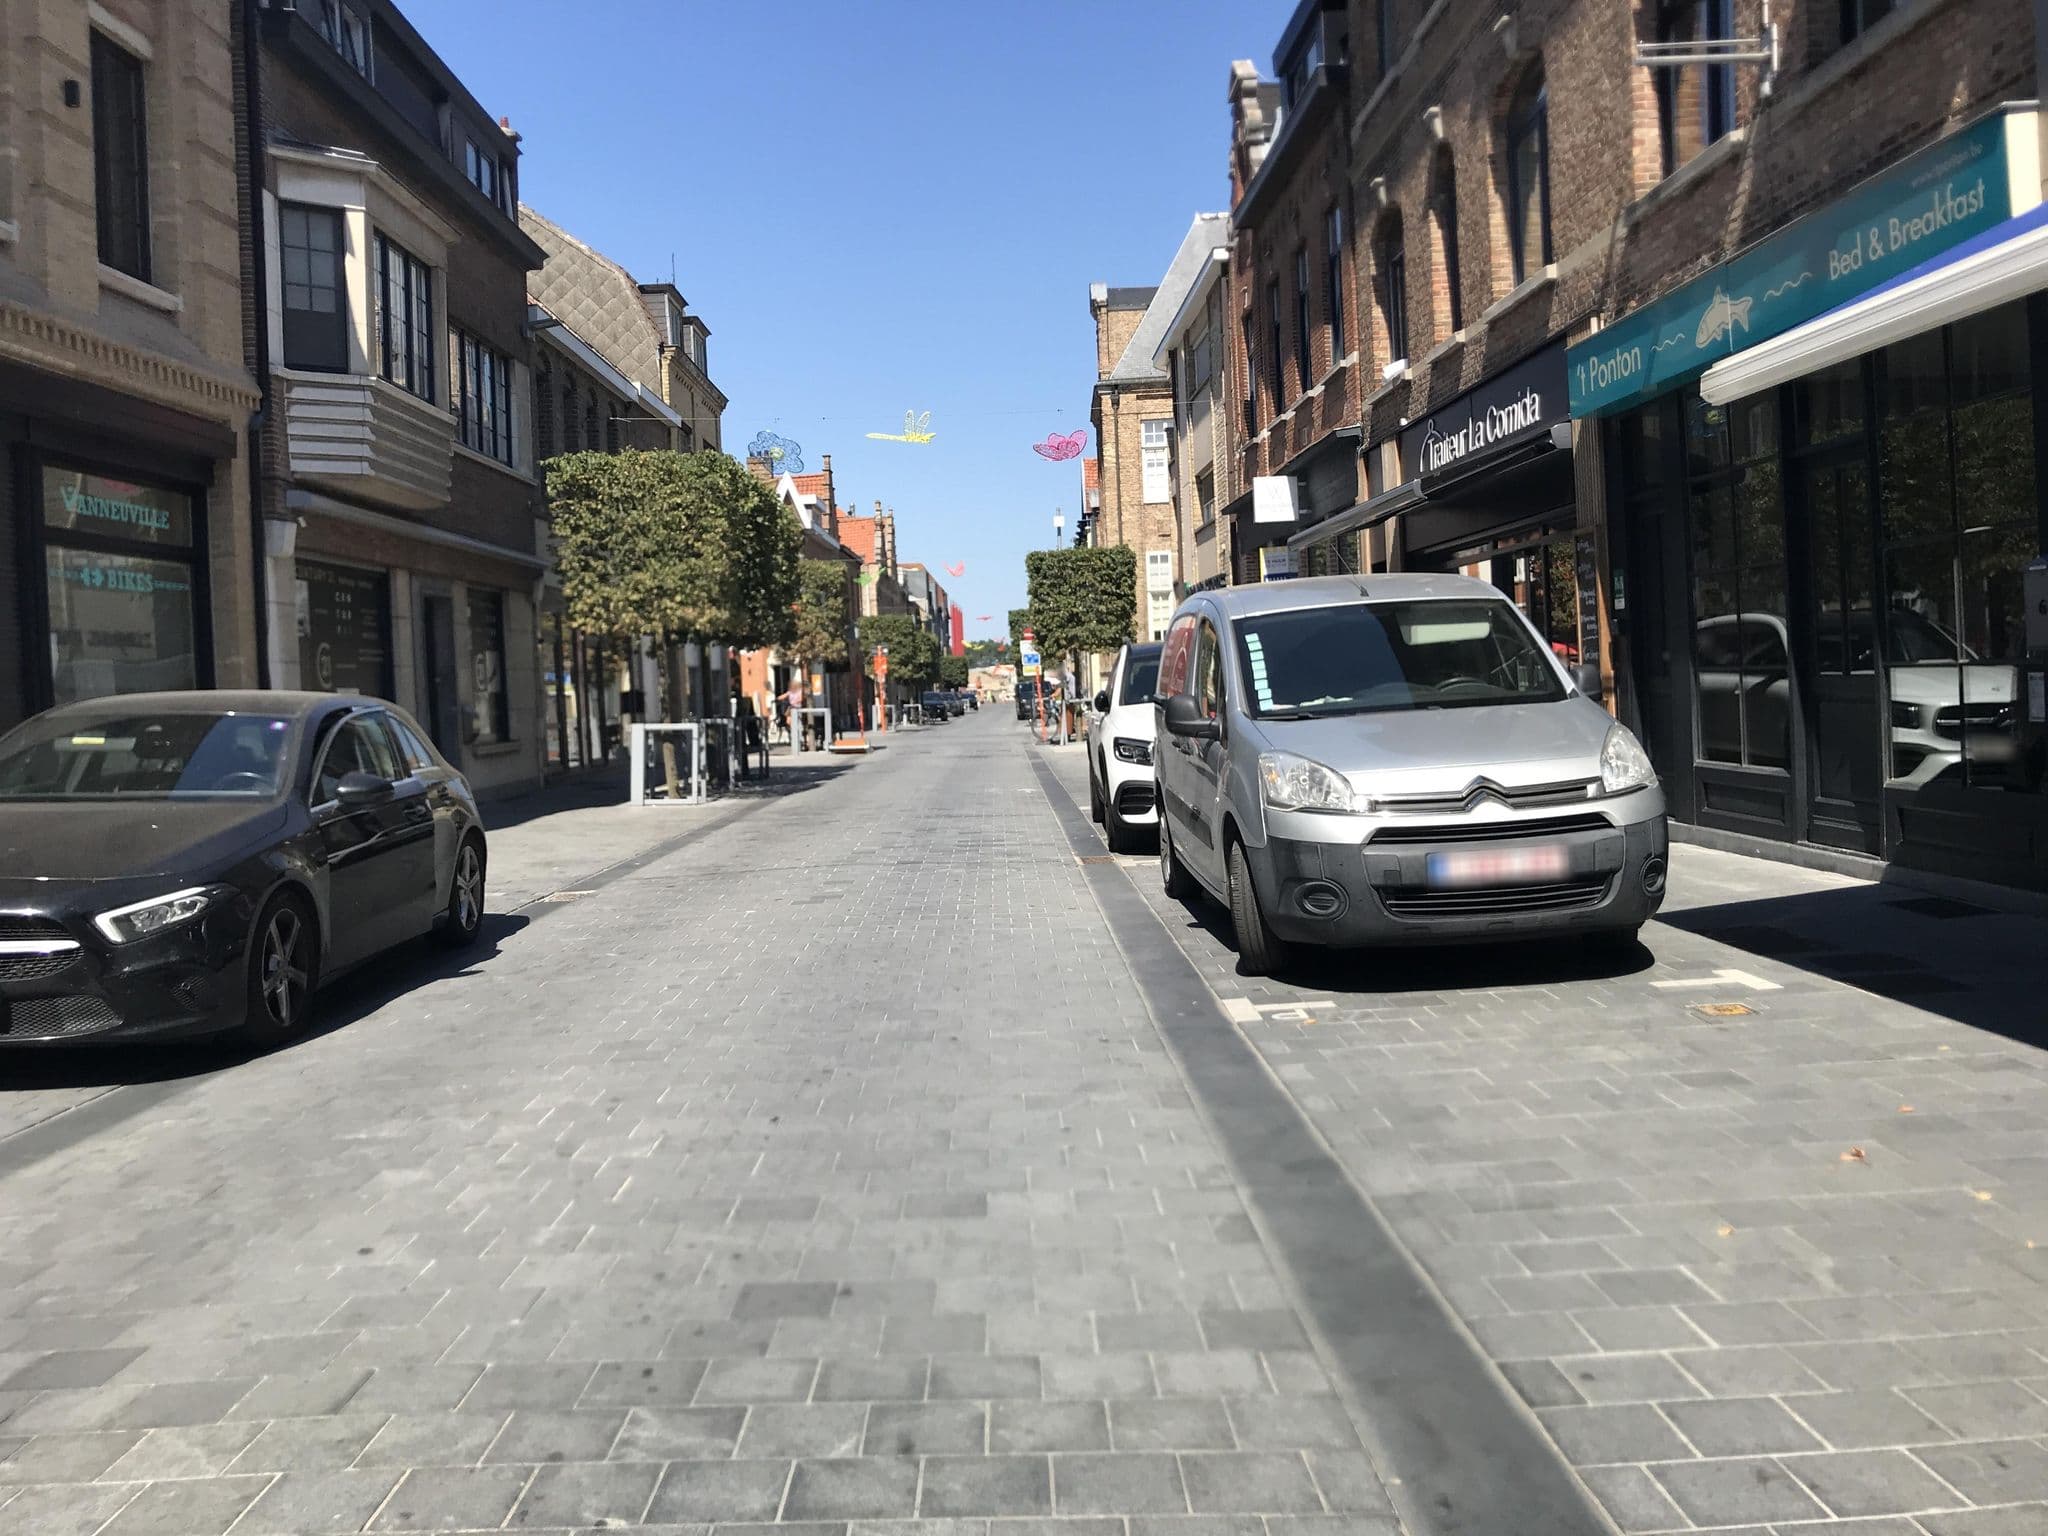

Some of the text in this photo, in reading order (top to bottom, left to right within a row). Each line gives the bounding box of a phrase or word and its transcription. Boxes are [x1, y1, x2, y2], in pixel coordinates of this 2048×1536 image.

[1589, 346, 1641, 391] Ponton
[1829, 231, 1862, 280] Bed
[1869, 227, 1884, 261] &
[1889, 178, 1985, 251] Breakfast
[1427, 387, 1541, 471] Traiteur La Comida
[60, 485, 170, 529] VANNEUVILLE
[107, 569, 153, 592] BIKES
